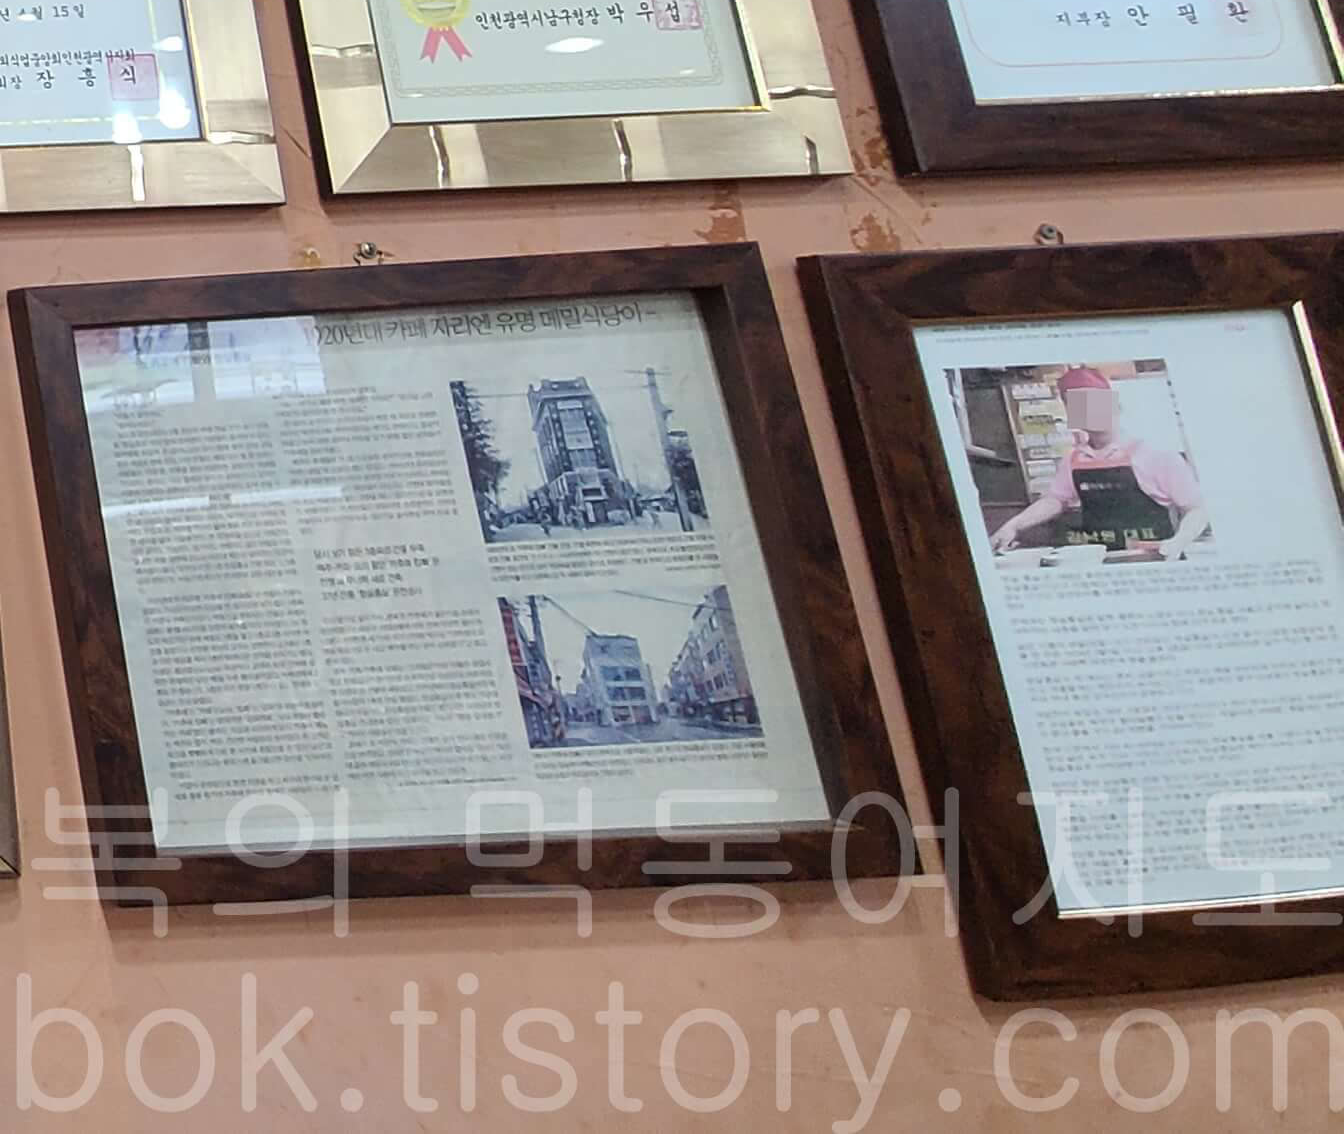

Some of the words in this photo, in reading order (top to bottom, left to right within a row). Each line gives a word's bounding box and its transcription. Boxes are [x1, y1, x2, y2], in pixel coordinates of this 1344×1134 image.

[386, 320, 427, 340] 카페
[433, 315, 491, 337] 자리엔
[497, 312, 536, 333] 유명
